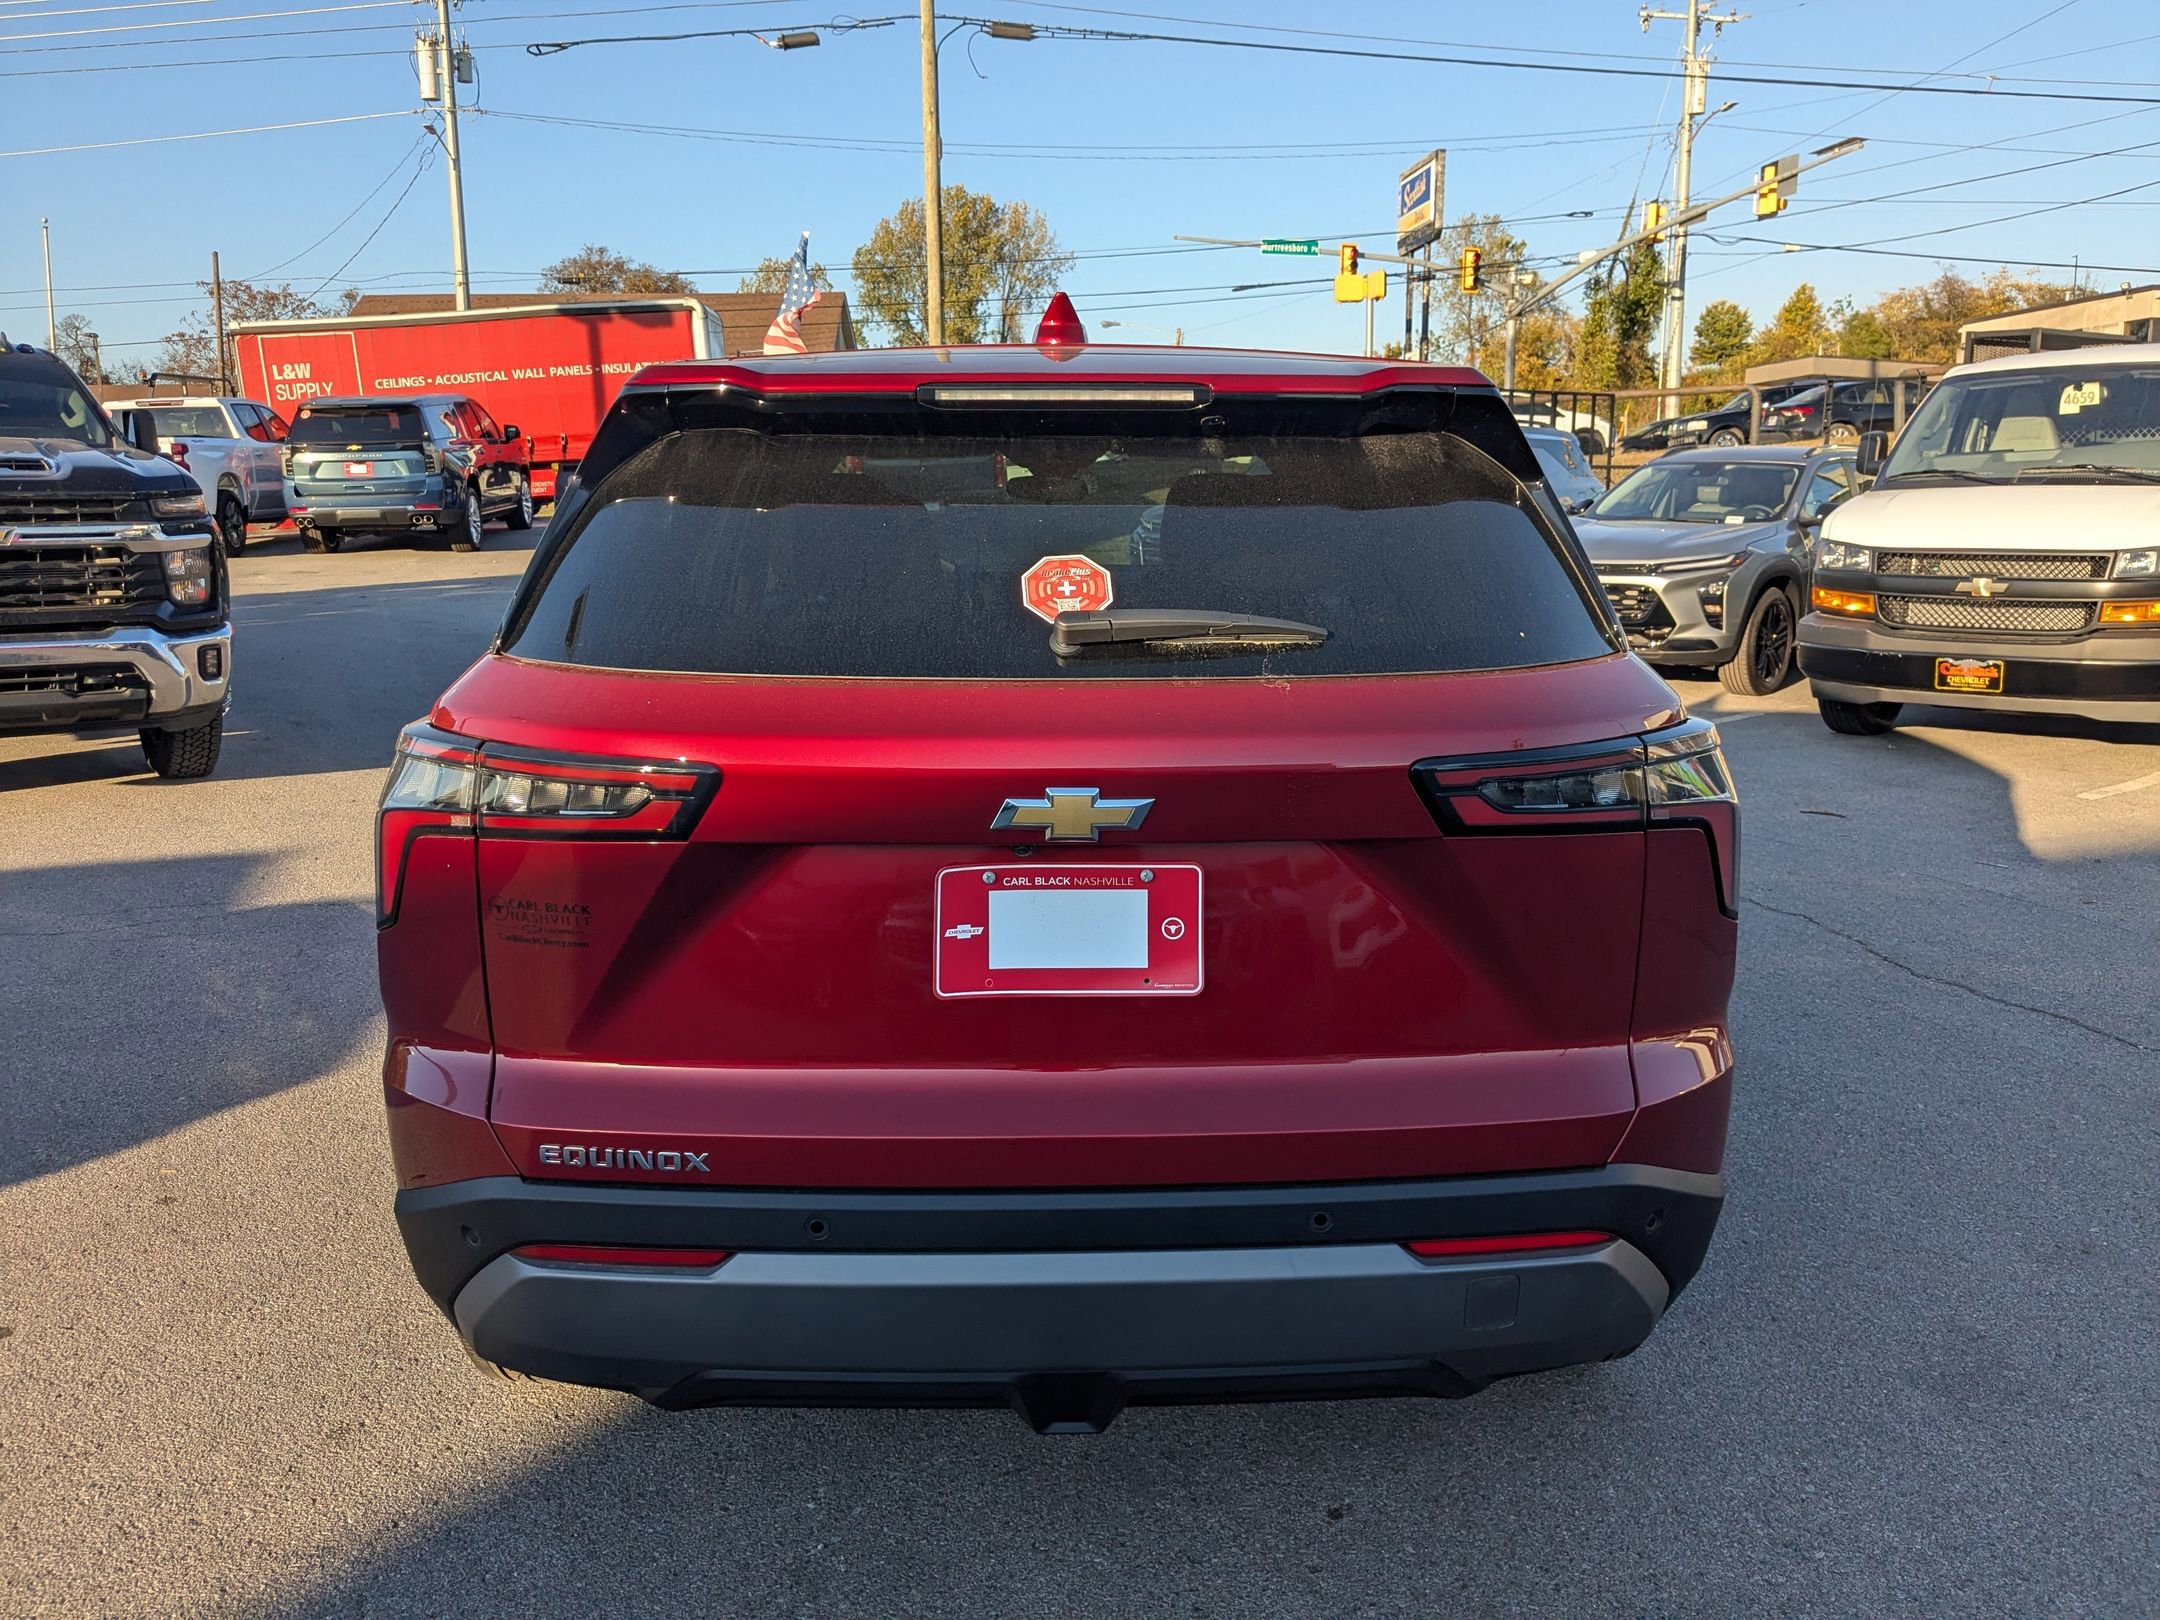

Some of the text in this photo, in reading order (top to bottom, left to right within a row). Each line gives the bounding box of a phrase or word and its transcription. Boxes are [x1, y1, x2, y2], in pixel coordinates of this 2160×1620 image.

[272, 362, 311, 380] L&W
[375, 360, 666, 389] CEILINGS ACOUSTICAL WALL PANELS INSULAT
[276, 381, 333, 401] SUPPLY
[2063, 391, 2095, 405] 4659
[1946, 676, 1990, 685] CHEVROLET
[1003, 876, 1134, 886] CARL BLACK NASHVILLE
[508, 898, 591, 916] CARL BLACK
[510, 911, 592, 927] NASHVILLE
[539, 1143, 711, 1173] EQUINOX
